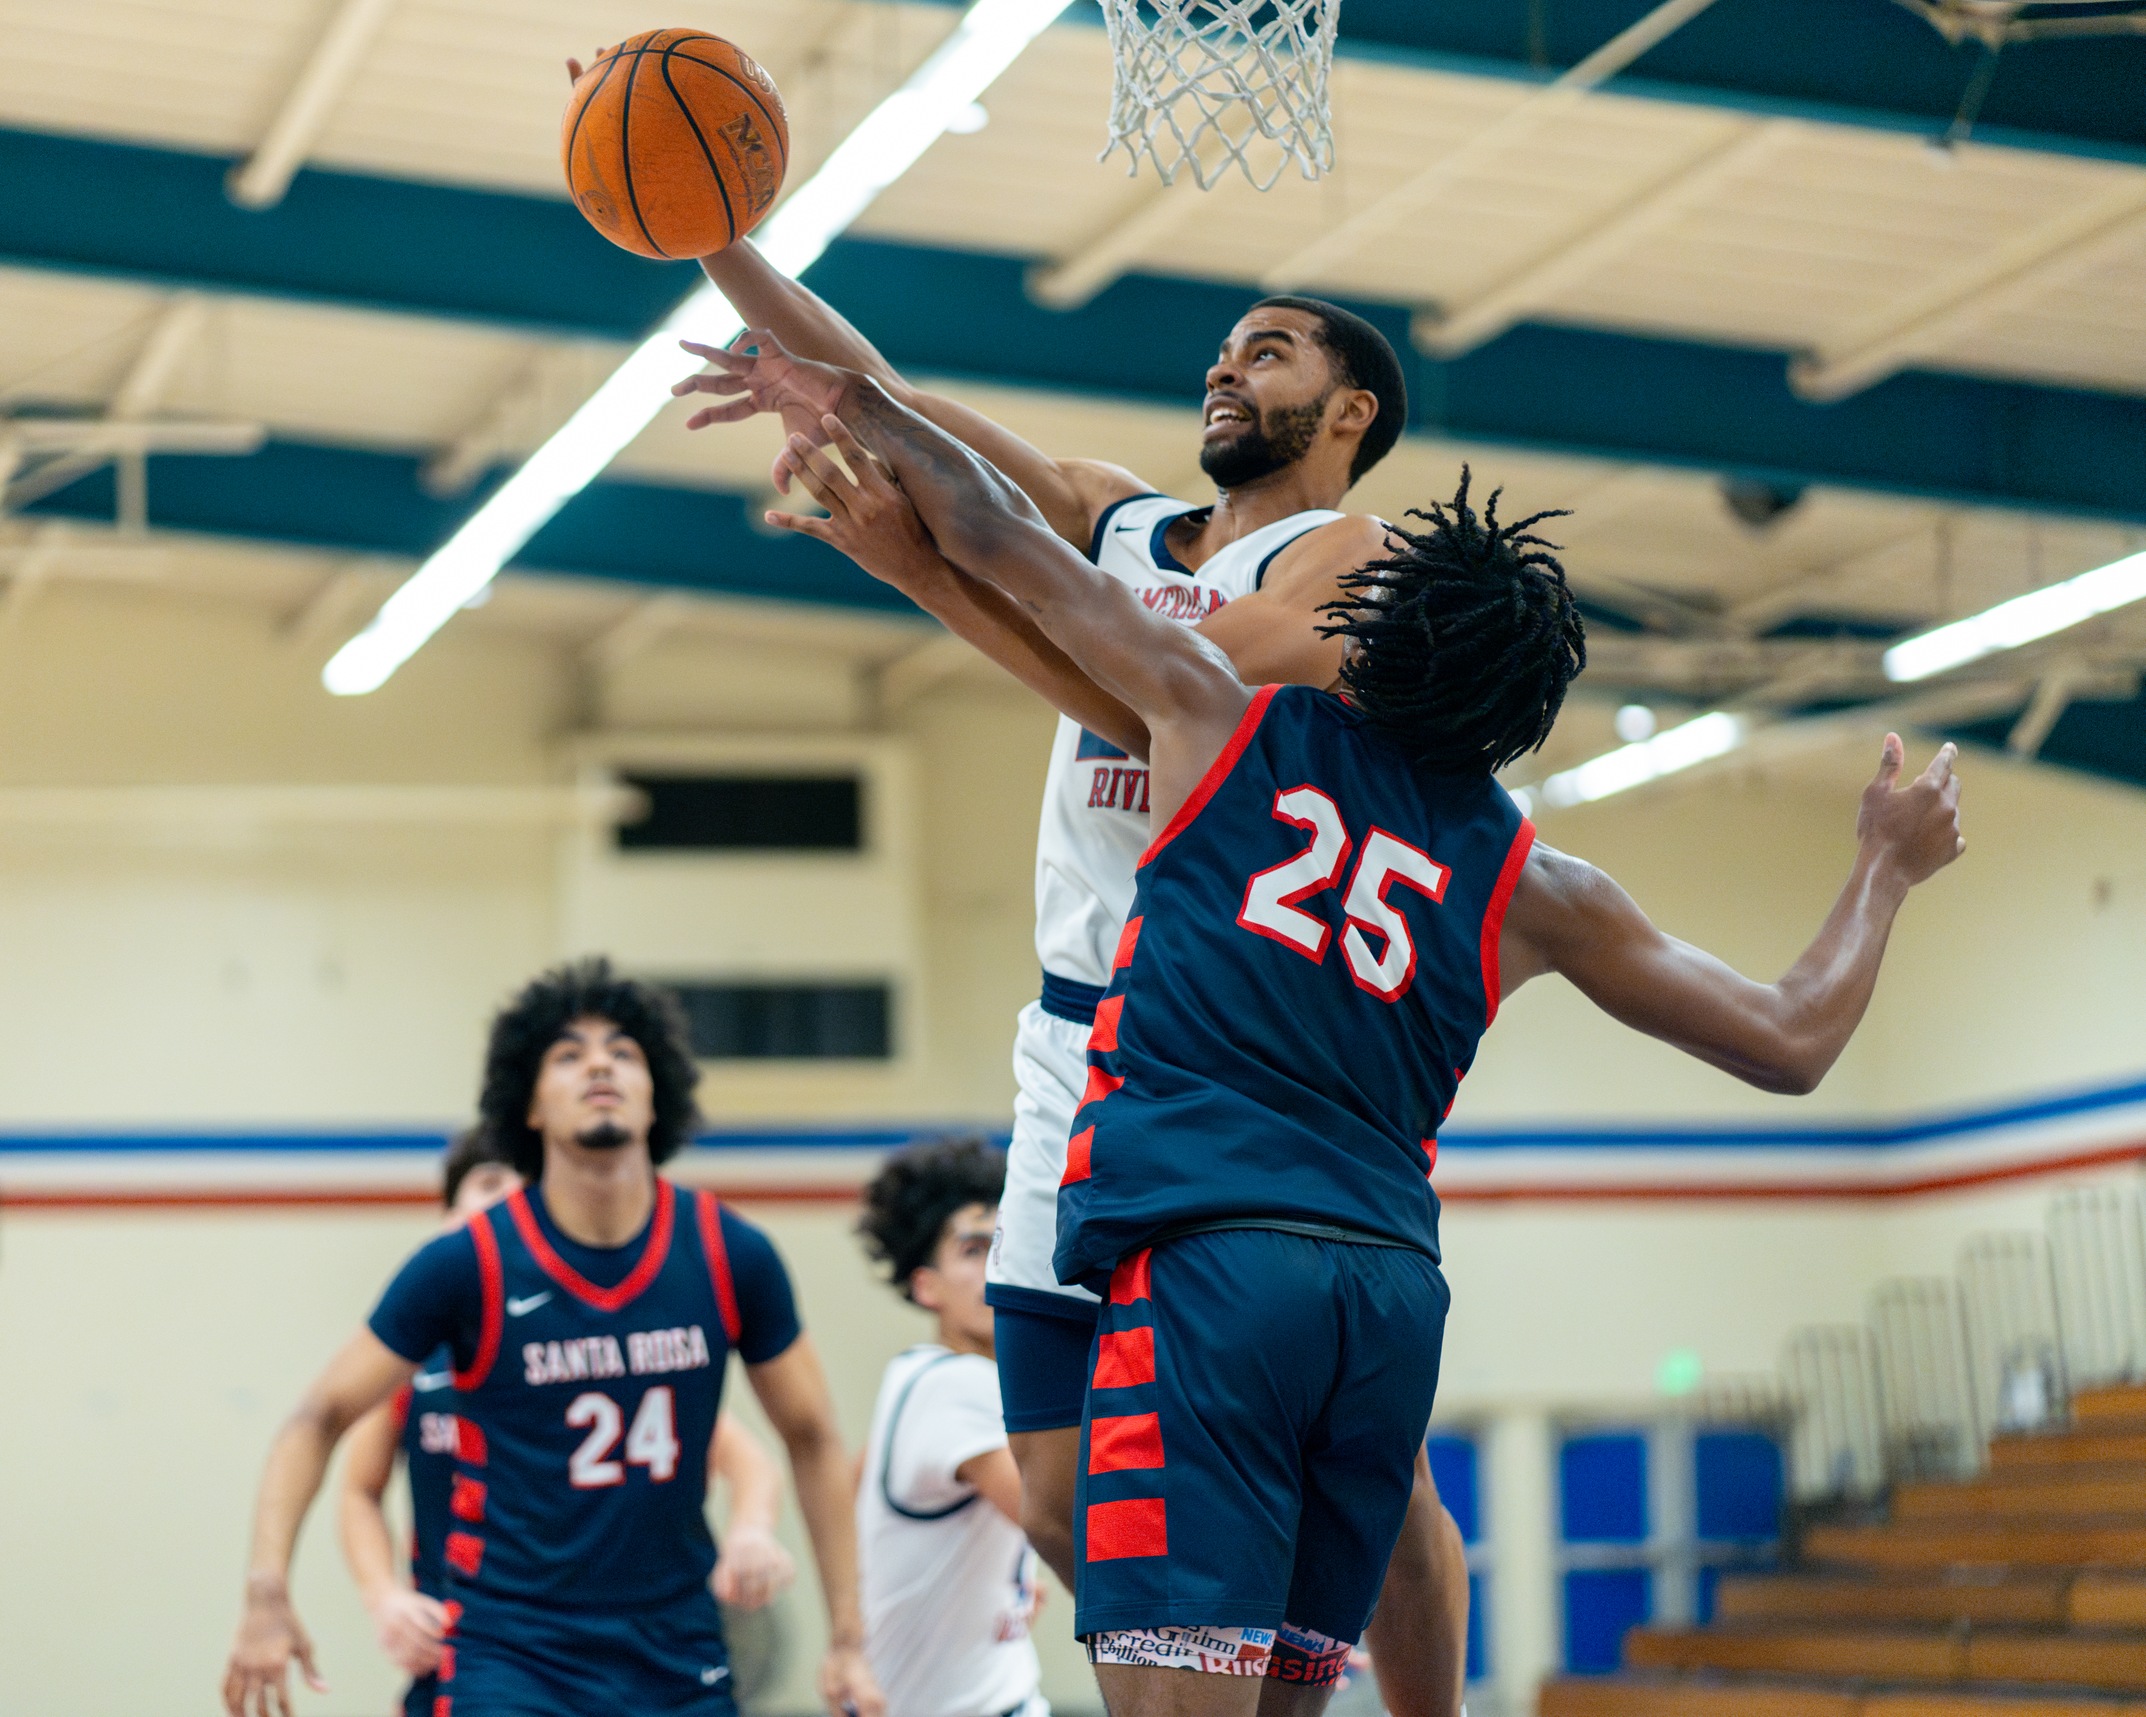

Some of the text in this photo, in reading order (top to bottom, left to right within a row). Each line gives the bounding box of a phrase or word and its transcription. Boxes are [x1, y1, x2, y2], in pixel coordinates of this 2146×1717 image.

[1236, 783, 1452, 1004] 25
[522, 1325, 710, 1386] SANTA ROSA
[564, 1385, 681, 1489] 24
